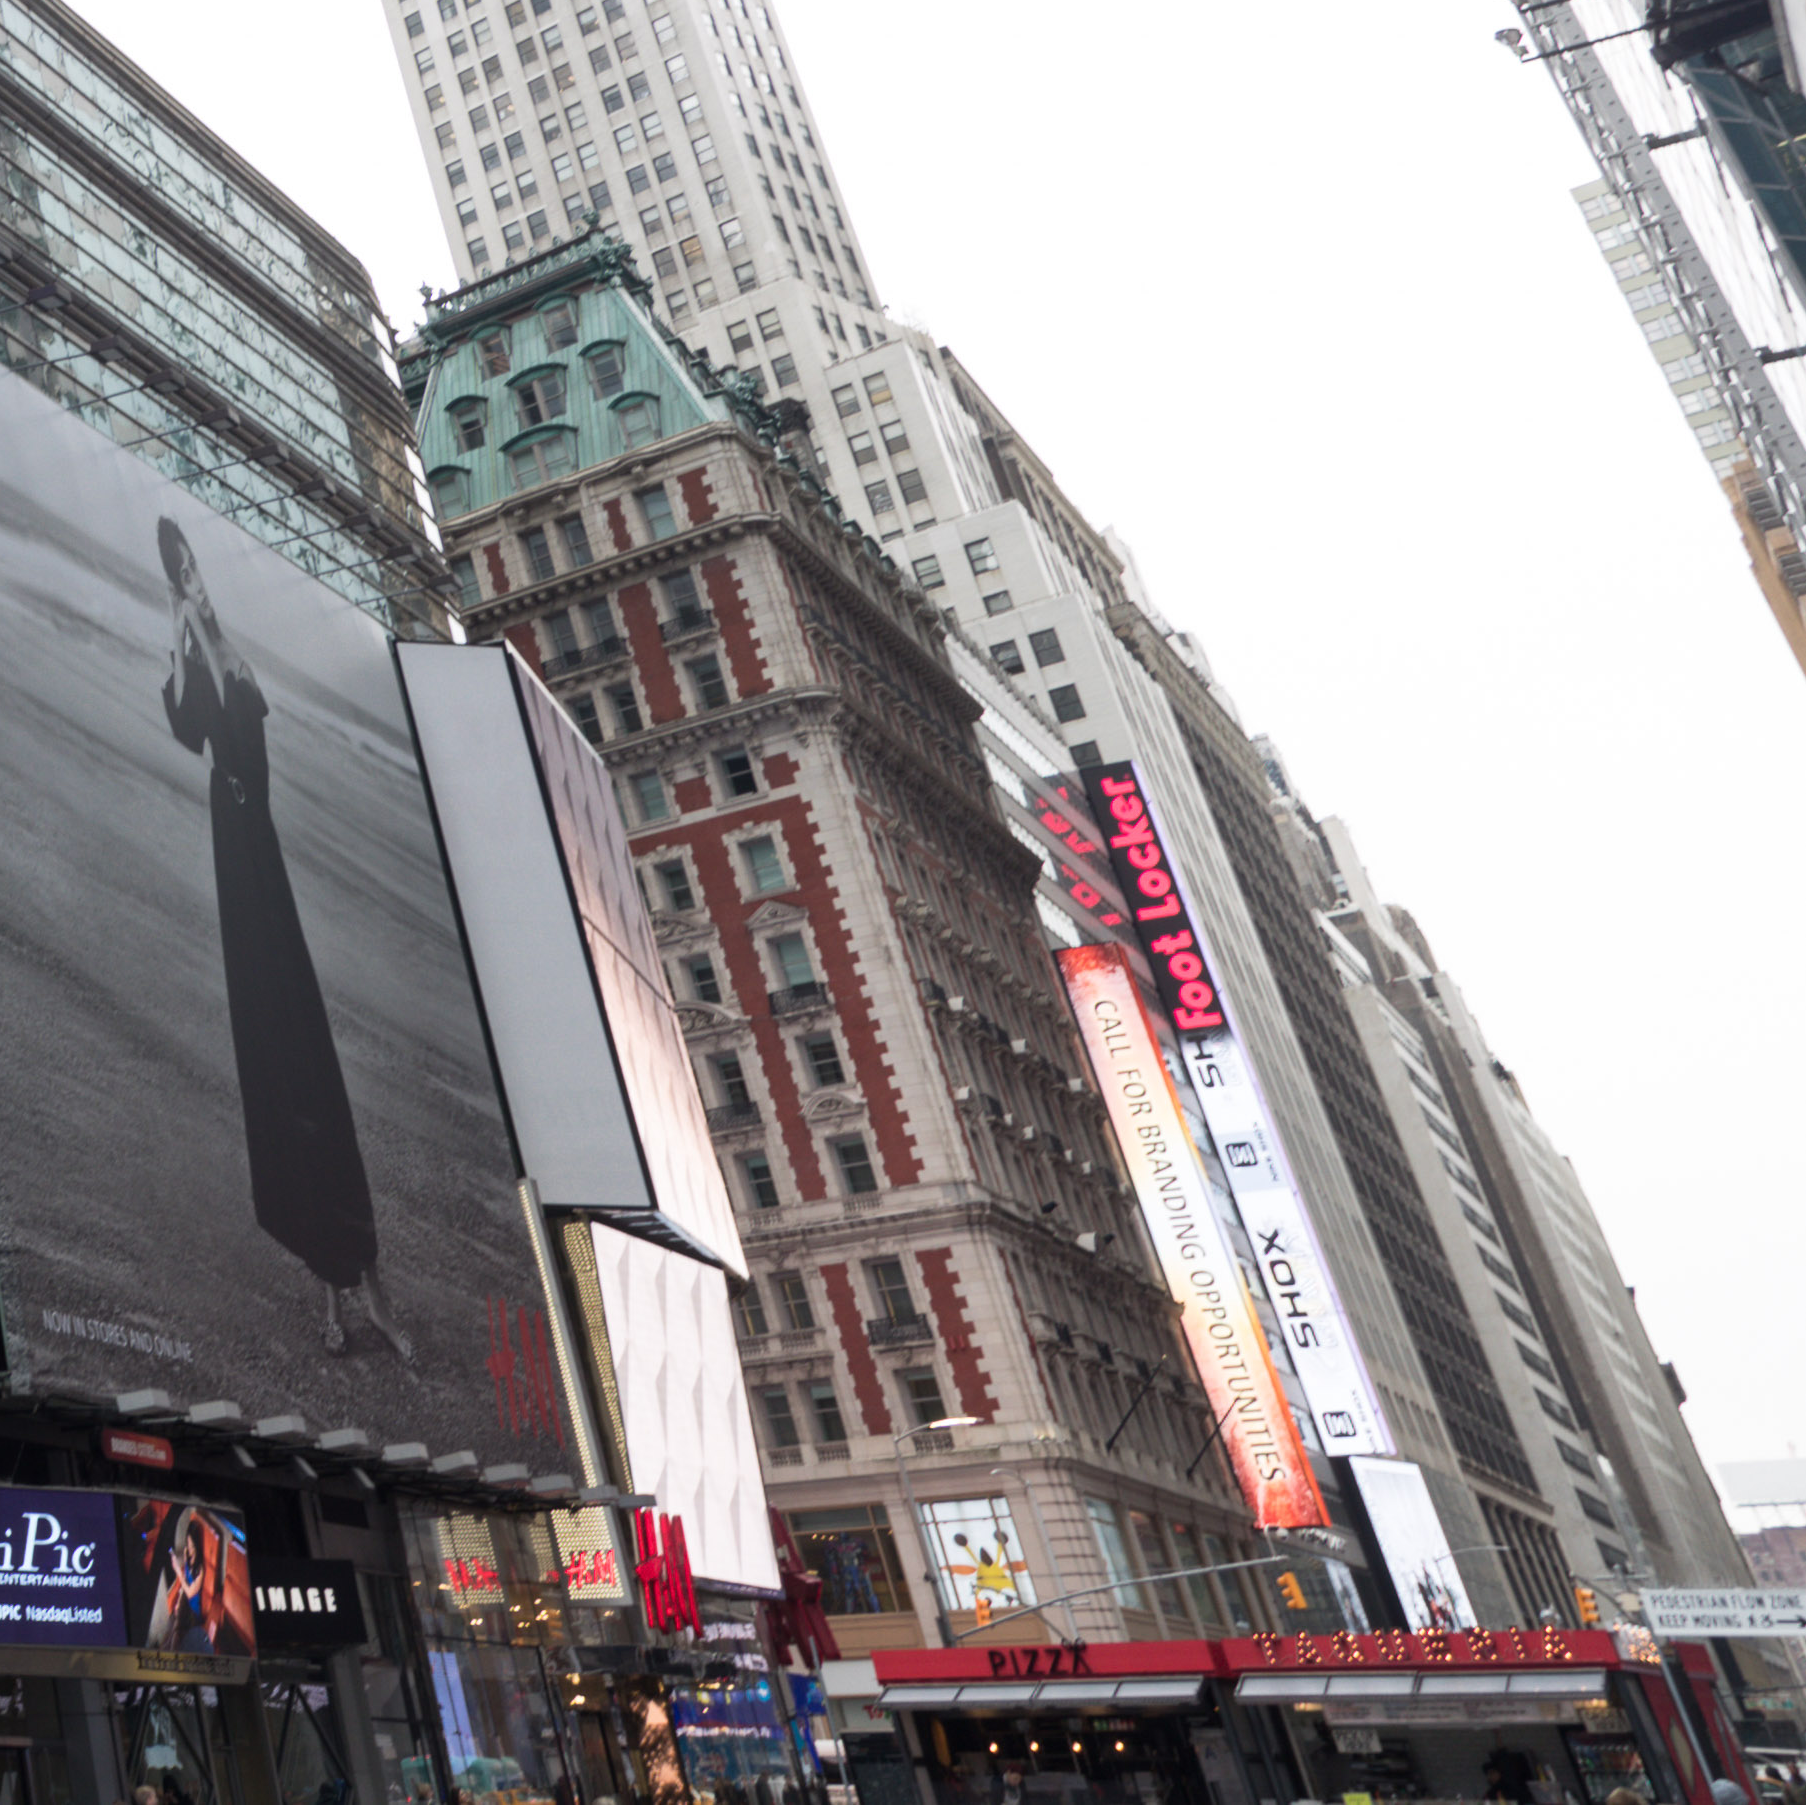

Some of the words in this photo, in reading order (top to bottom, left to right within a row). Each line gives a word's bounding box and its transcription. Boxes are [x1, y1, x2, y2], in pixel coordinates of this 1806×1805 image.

[1100, 776, 1181, 921] Locker
[1151, 929, 1223, 1030] Foot
[1095, 999, 1133, 1059] CALL
[1117, 1068, 1153, 1115] FOR
[1138, 1124, 1206, 1261] BRANDING
[1190, 1268, 1286, 1482] OPPORTUNITIES
[1257, 1229, 1320, 1349] SHOX
[43, 1310, 72, 1335] NOW
[72, 1315, 87, 1338] IN
[87, 1318, 127, 1347] STORES
[129, 1329, 154, 1353] AND
[564, 1549, 616, 1588] H&M
[635, 1507, 704, 1639] H&M
[255, 1586, 337, 1613] IMAGE
[1650, 1594, 1729, 1610] PEDESTRIAN
[1730, 1594, 1765, 1610] FLOW
[1770, 1594, 1802, 1610] ZONE
[987, 1648, 1093, 1677] PIZZA
[1251, 1623, 1574, 1665] TAQUERIA
